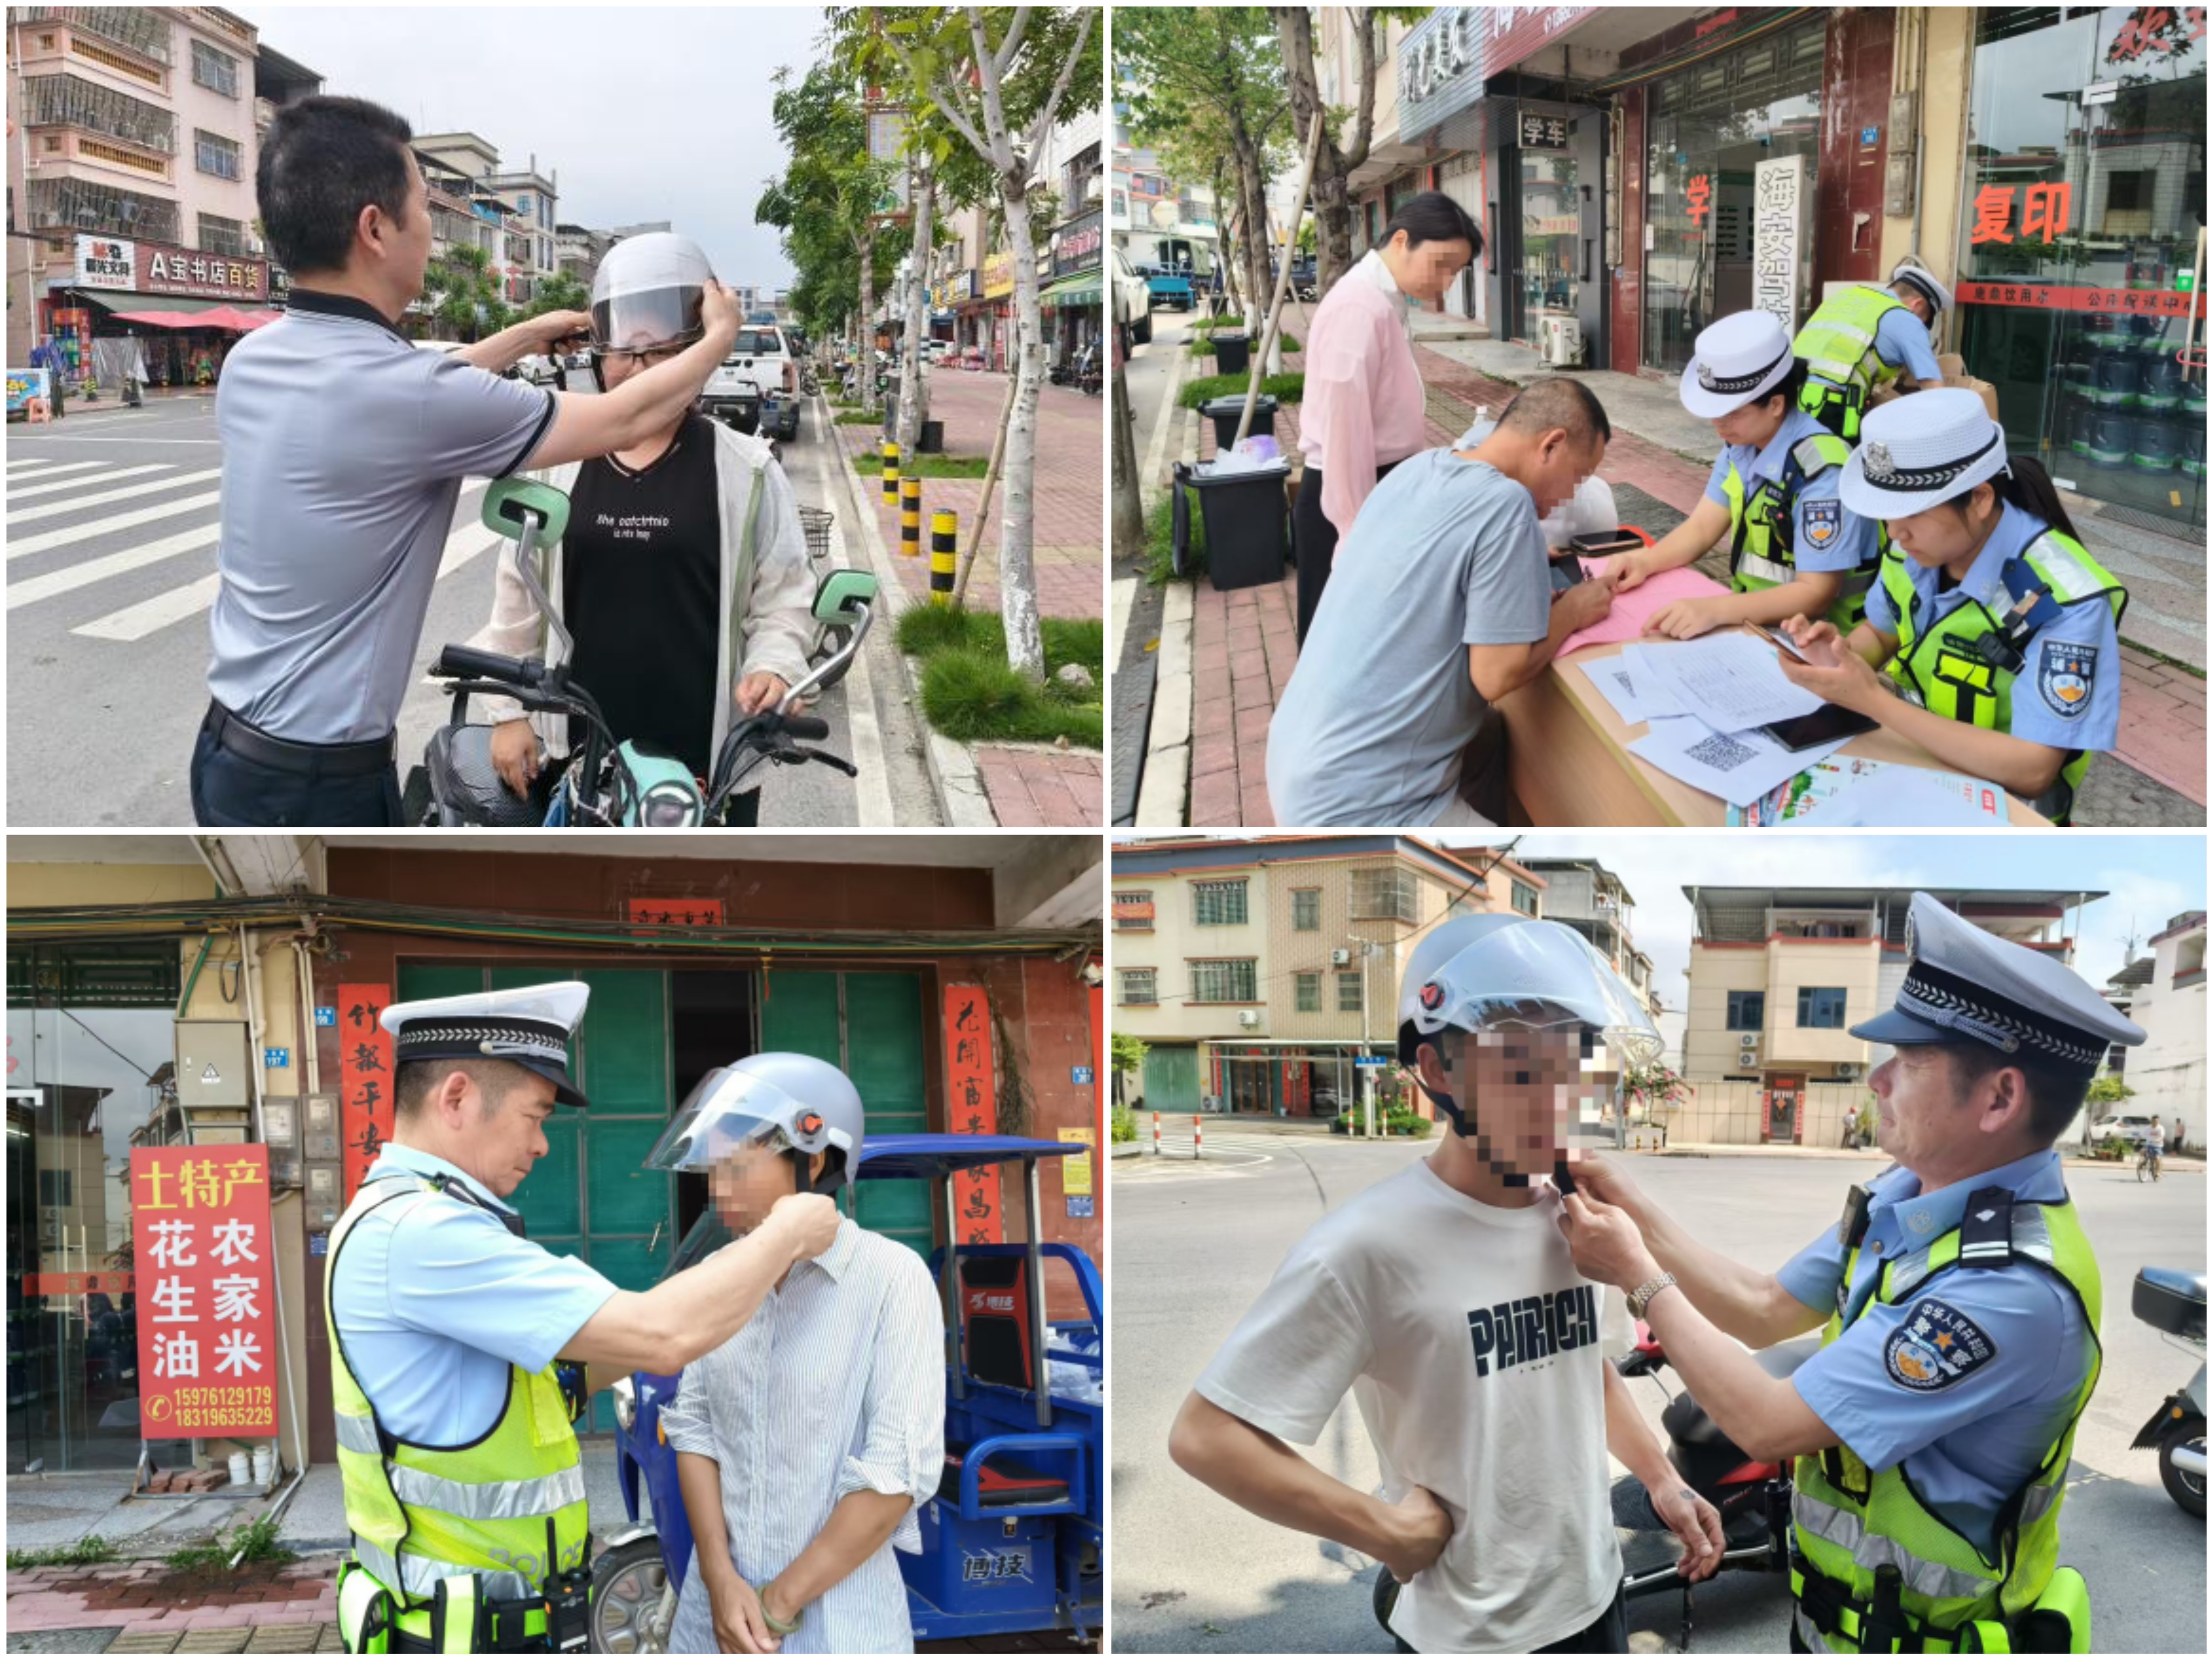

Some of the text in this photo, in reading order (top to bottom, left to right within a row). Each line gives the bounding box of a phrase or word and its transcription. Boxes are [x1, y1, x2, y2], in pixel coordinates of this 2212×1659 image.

[1524, 117, 1565, 146] 学车
[1686, 174, 1710, 226] 学
[1970, 181, 2072, 245] 复印
[347, 1000, 388, 1188] 竹報平安
[137, 1159, 264, 1210] 土特产
[148, 1218, 200, 1378] 花生油
[209, 1218, 263, 1378] 农家米
[174, 1386, 272, 1407] 15976129179
[175, 1406, 273, 1427] 18319635229
[489, 1540, 582, 1586] POLCE
